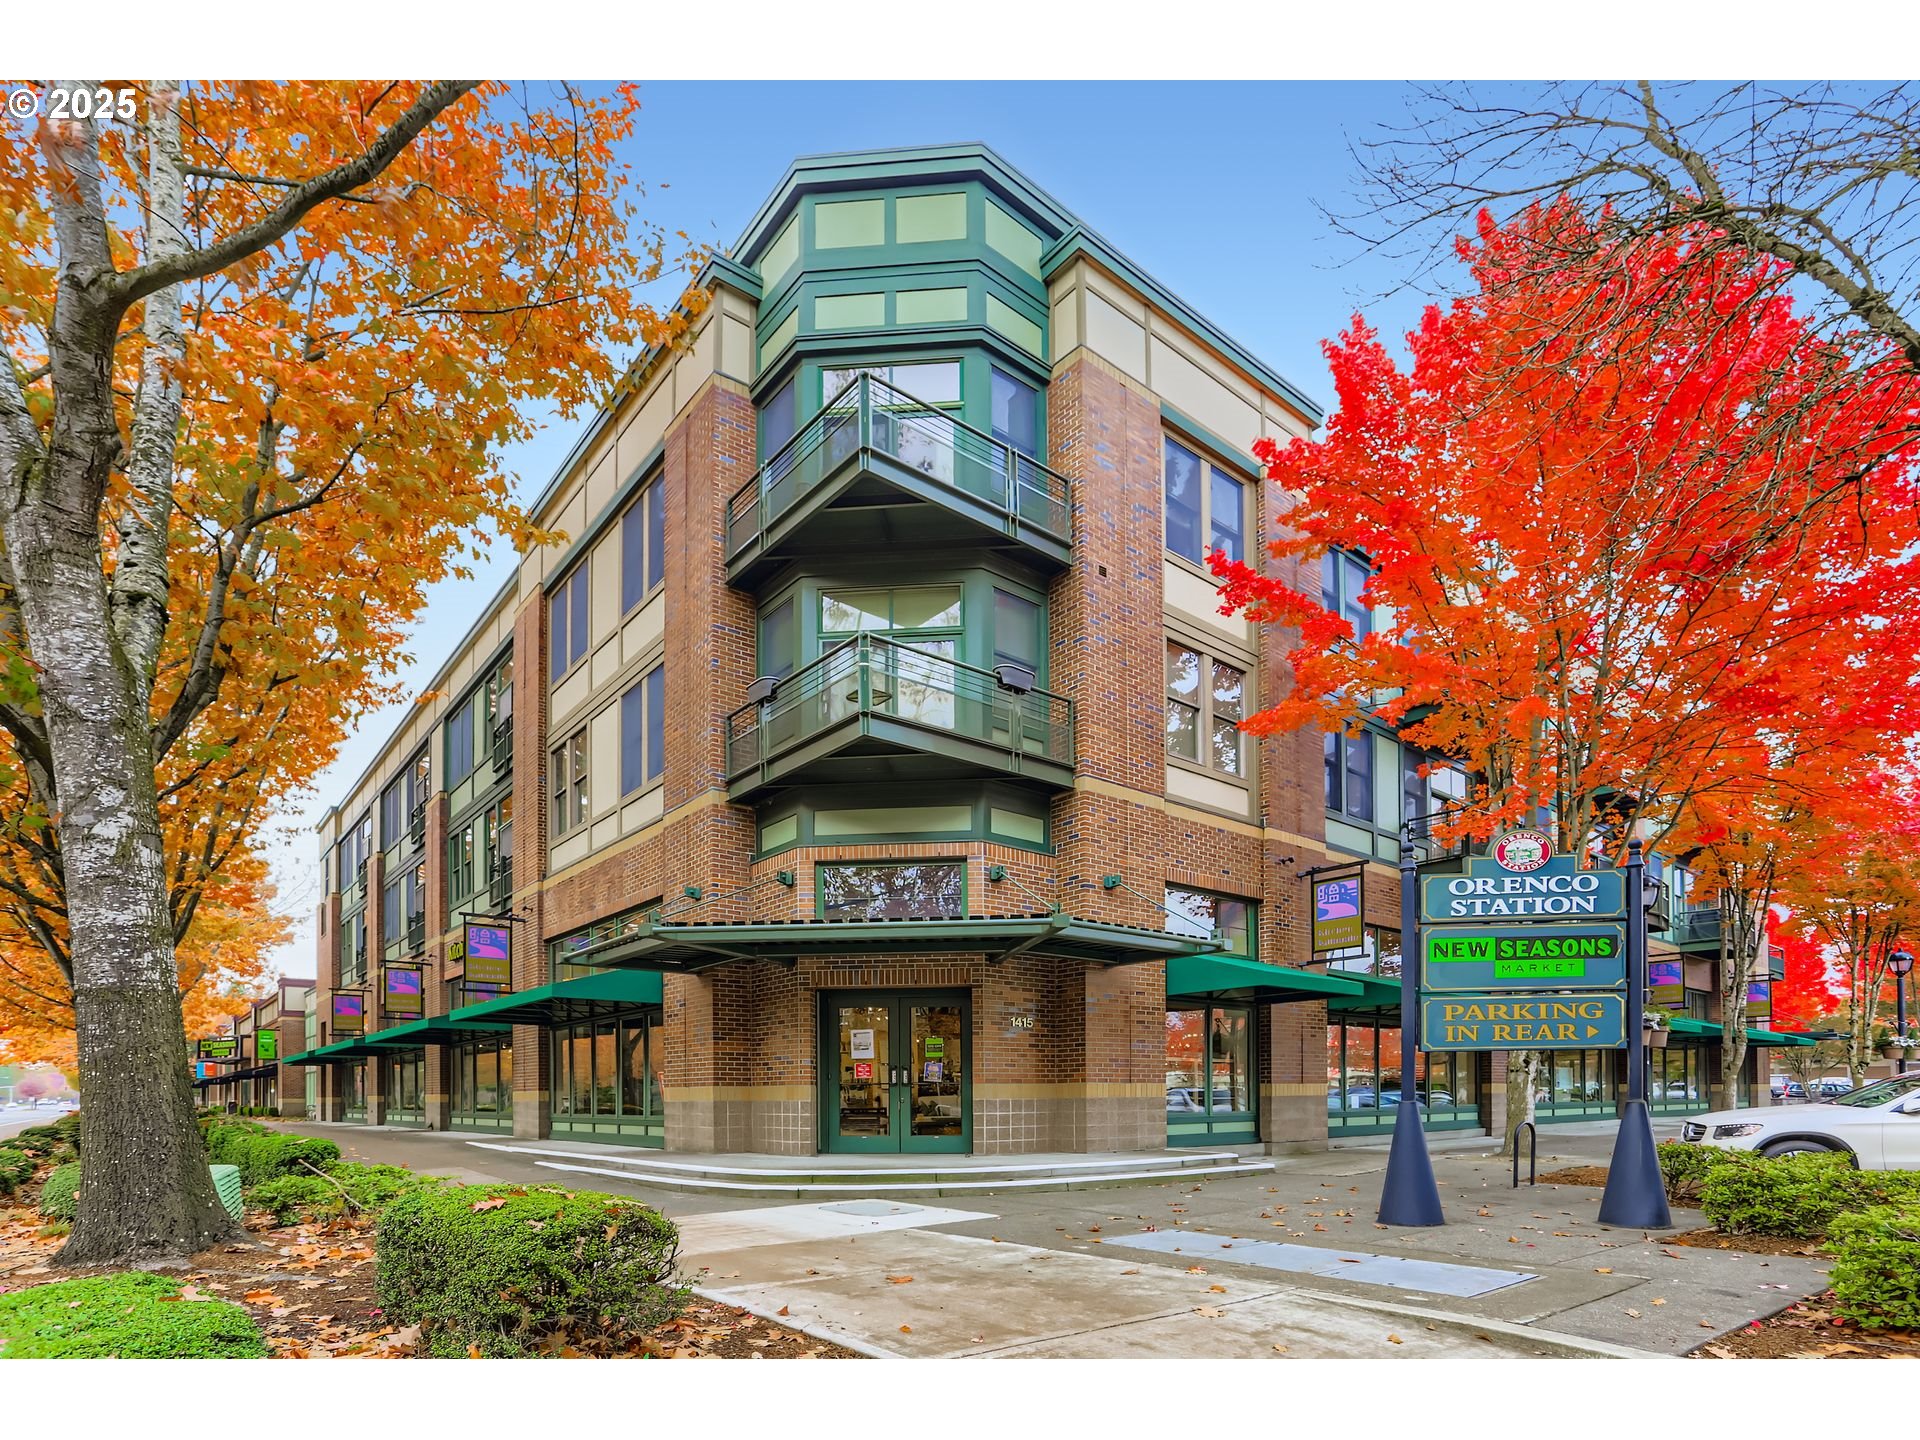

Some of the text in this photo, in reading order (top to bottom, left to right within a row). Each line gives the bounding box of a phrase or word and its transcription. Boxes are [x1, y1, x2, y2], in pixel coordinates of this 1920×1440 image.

[1502, 832, 1545, 846] ORENCO
[1501, 858, 1545, 871] STATION
[1448, 874, 1599, 896] ORENCO
[1450, 895, 1598, 917] STATION
[1433, 938, 1612, 959] NEW SEASONS
[1501, 963, 1576, 974] MARKET
[1442, 1002, 1605, 1021] PARKING
[1010, 1016, 1034, 1028] 1415
[1445, 1023, 1581, 1042] IN REAR
